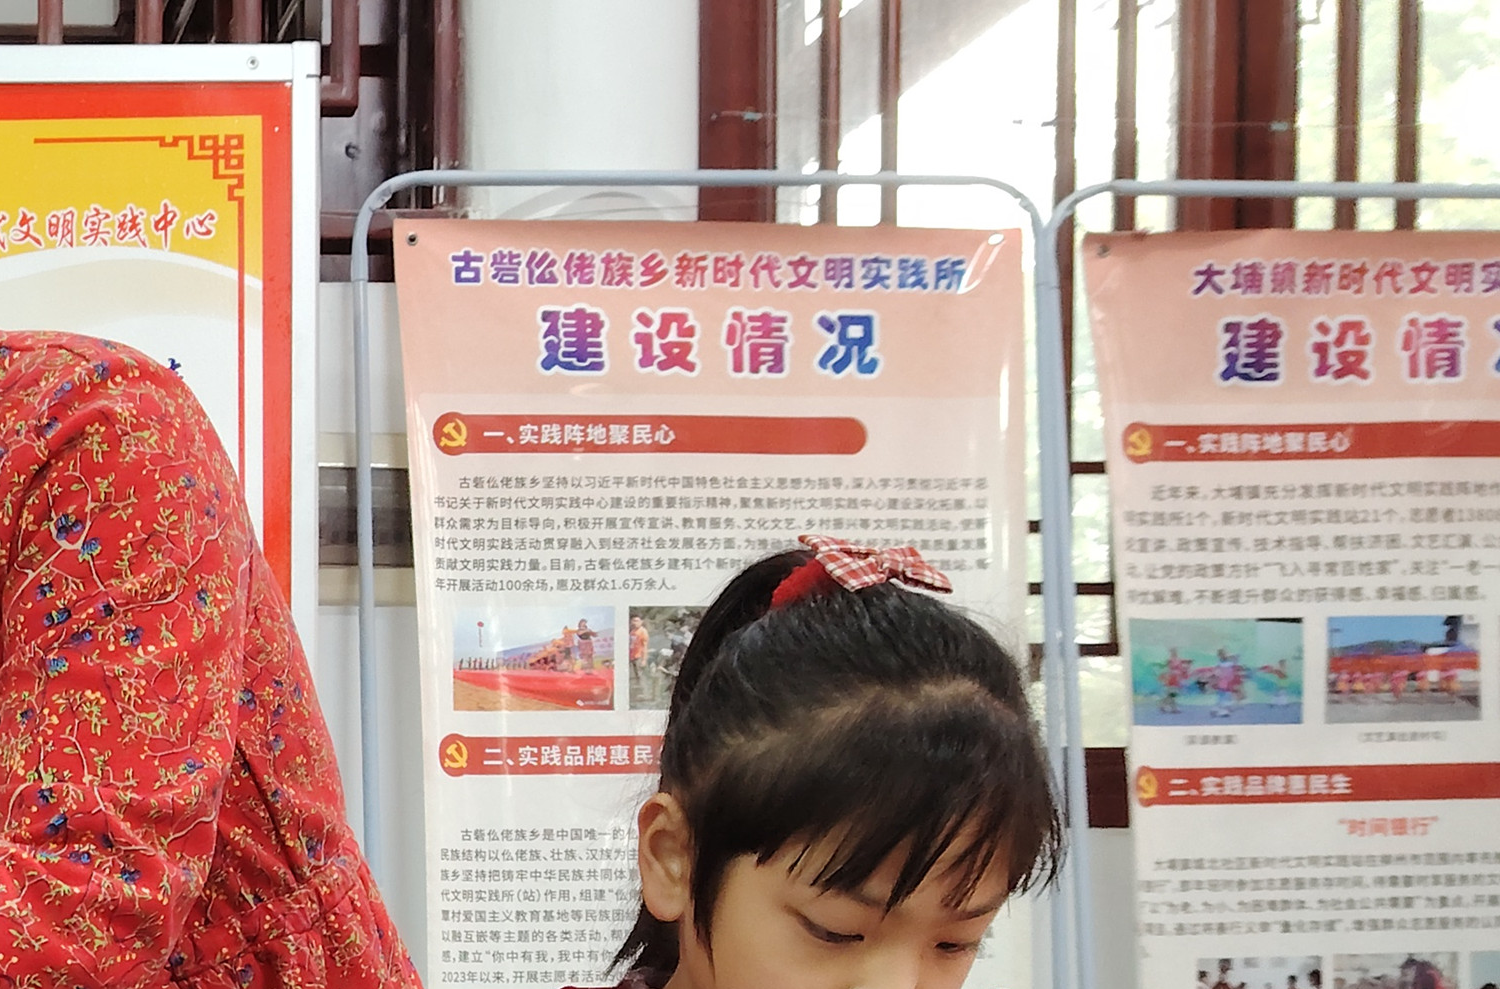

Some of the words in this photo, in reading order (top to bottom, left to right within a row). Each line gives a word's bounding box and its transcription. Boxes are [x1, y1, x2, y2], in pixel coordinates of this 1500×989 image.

[539, 309, 879, 374] 建设情况
[1220, 318, 1500, 382] 建设情
[483, 425, 675, 446] 一、实践阵地聚民心
[483, 745, 660, 767] 二、实践品牌惠民
[442, 929, 630, 943] 以融互嵌等主题的各类活动，帮
